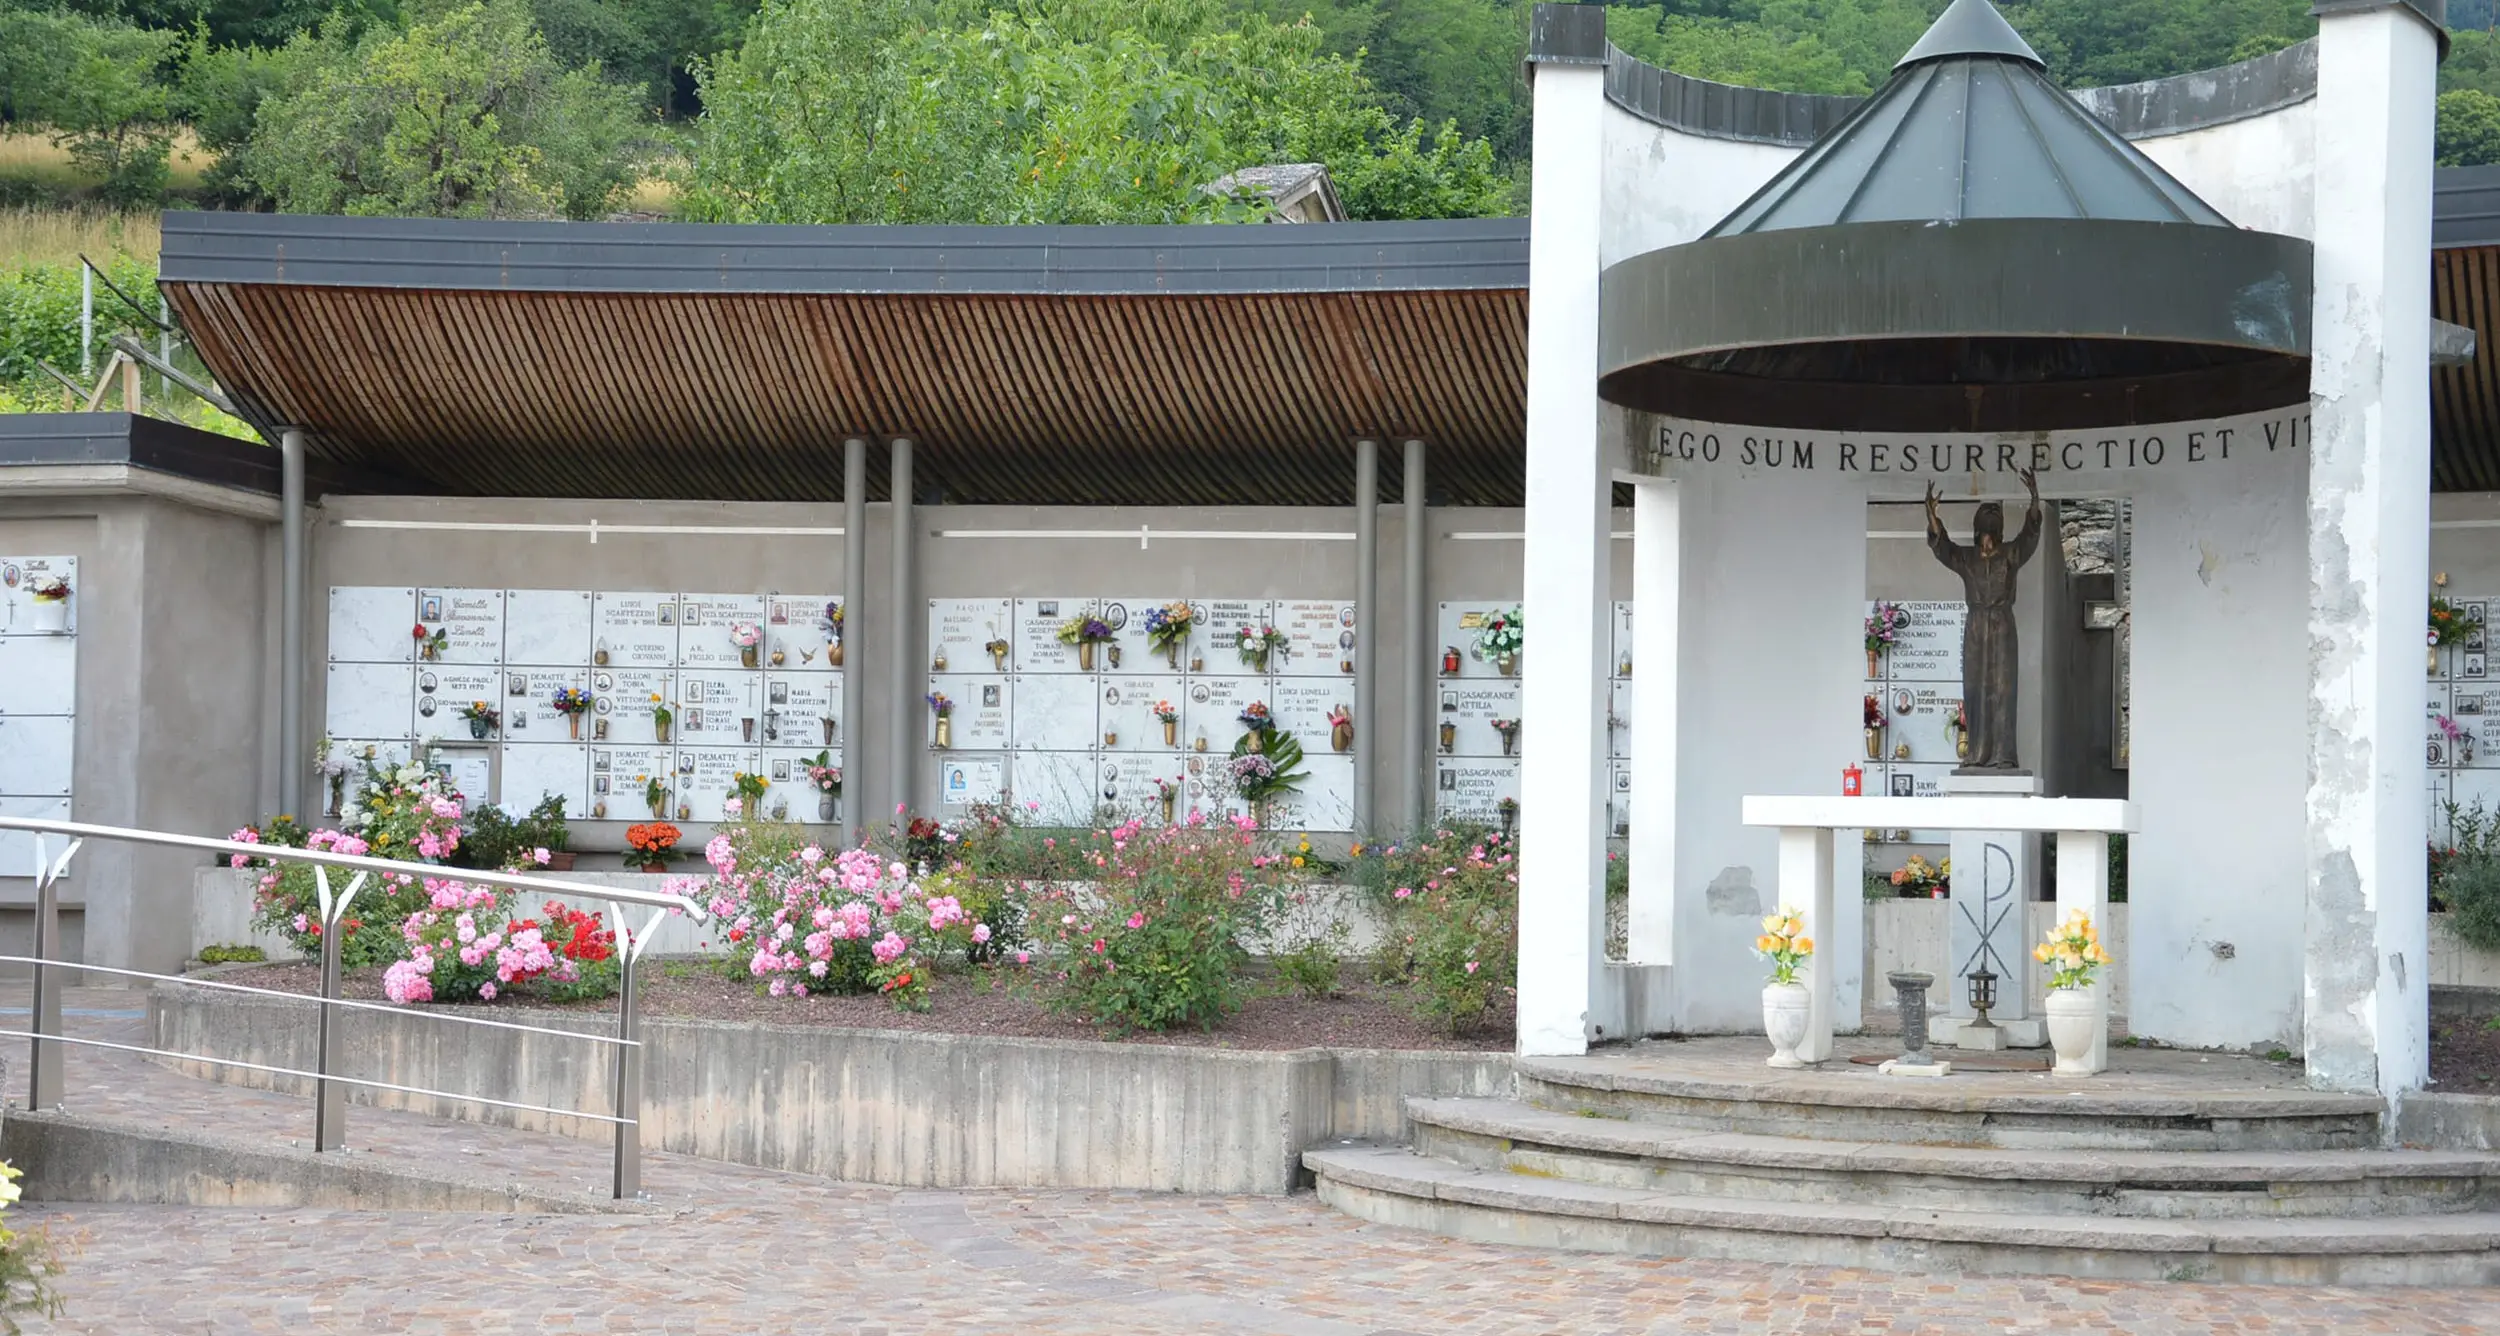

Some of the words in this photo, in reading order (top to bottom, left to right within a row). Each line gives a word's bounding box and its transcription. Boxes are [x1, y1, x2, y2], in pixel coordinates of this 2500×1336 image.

[1659, 427, 1720, 462] EGO
[1740, 437, 1815, 469] SUM
[1839, 436, 2165, 472] RESURRECTIO
[2187, 428, 2234, 462] ET
[1907, 602, 1965, 611] VISINTAINER
[1211, 611, 1251, 619] DEGASPERI
[472, 676, 493, 684] PAOLI
[618, 672, 652, 680] GALLONI
[1459, 691, 1516, 699] CASAGRANDE
[1459, 701, 1492, 709] ATTILIA
[1456, 768, 1515, 777] CASAGRANDE
[1457, 779, 1495, 787] AUGUSTA
[1464, 789, 1495, 797] LUNELLI
